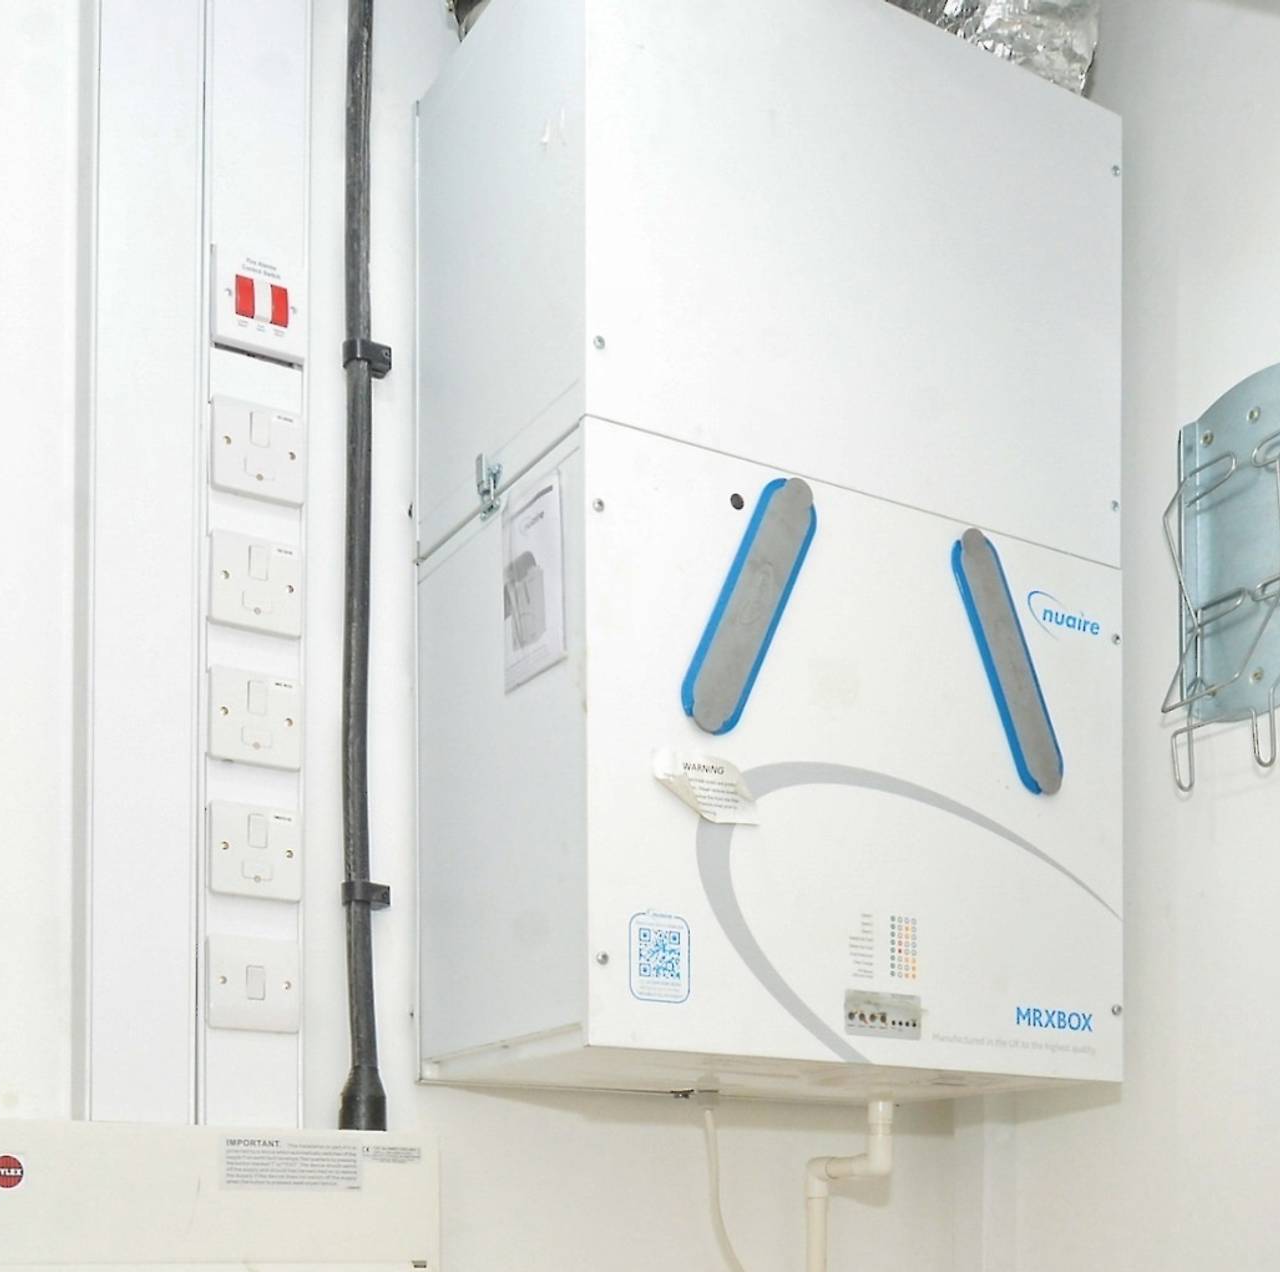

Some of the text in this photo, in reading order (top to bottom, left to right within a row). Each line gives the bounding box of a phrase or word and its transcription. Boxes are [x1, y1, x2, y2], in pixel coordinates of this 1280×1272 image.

[1043, 608, 1100, 635] nuaire
[682, 761, 725, 775] WARNING
[1015, 1006, 1093, 1032] MRXBOX
[225, 1139, 280, 1147] IMPORTANT
